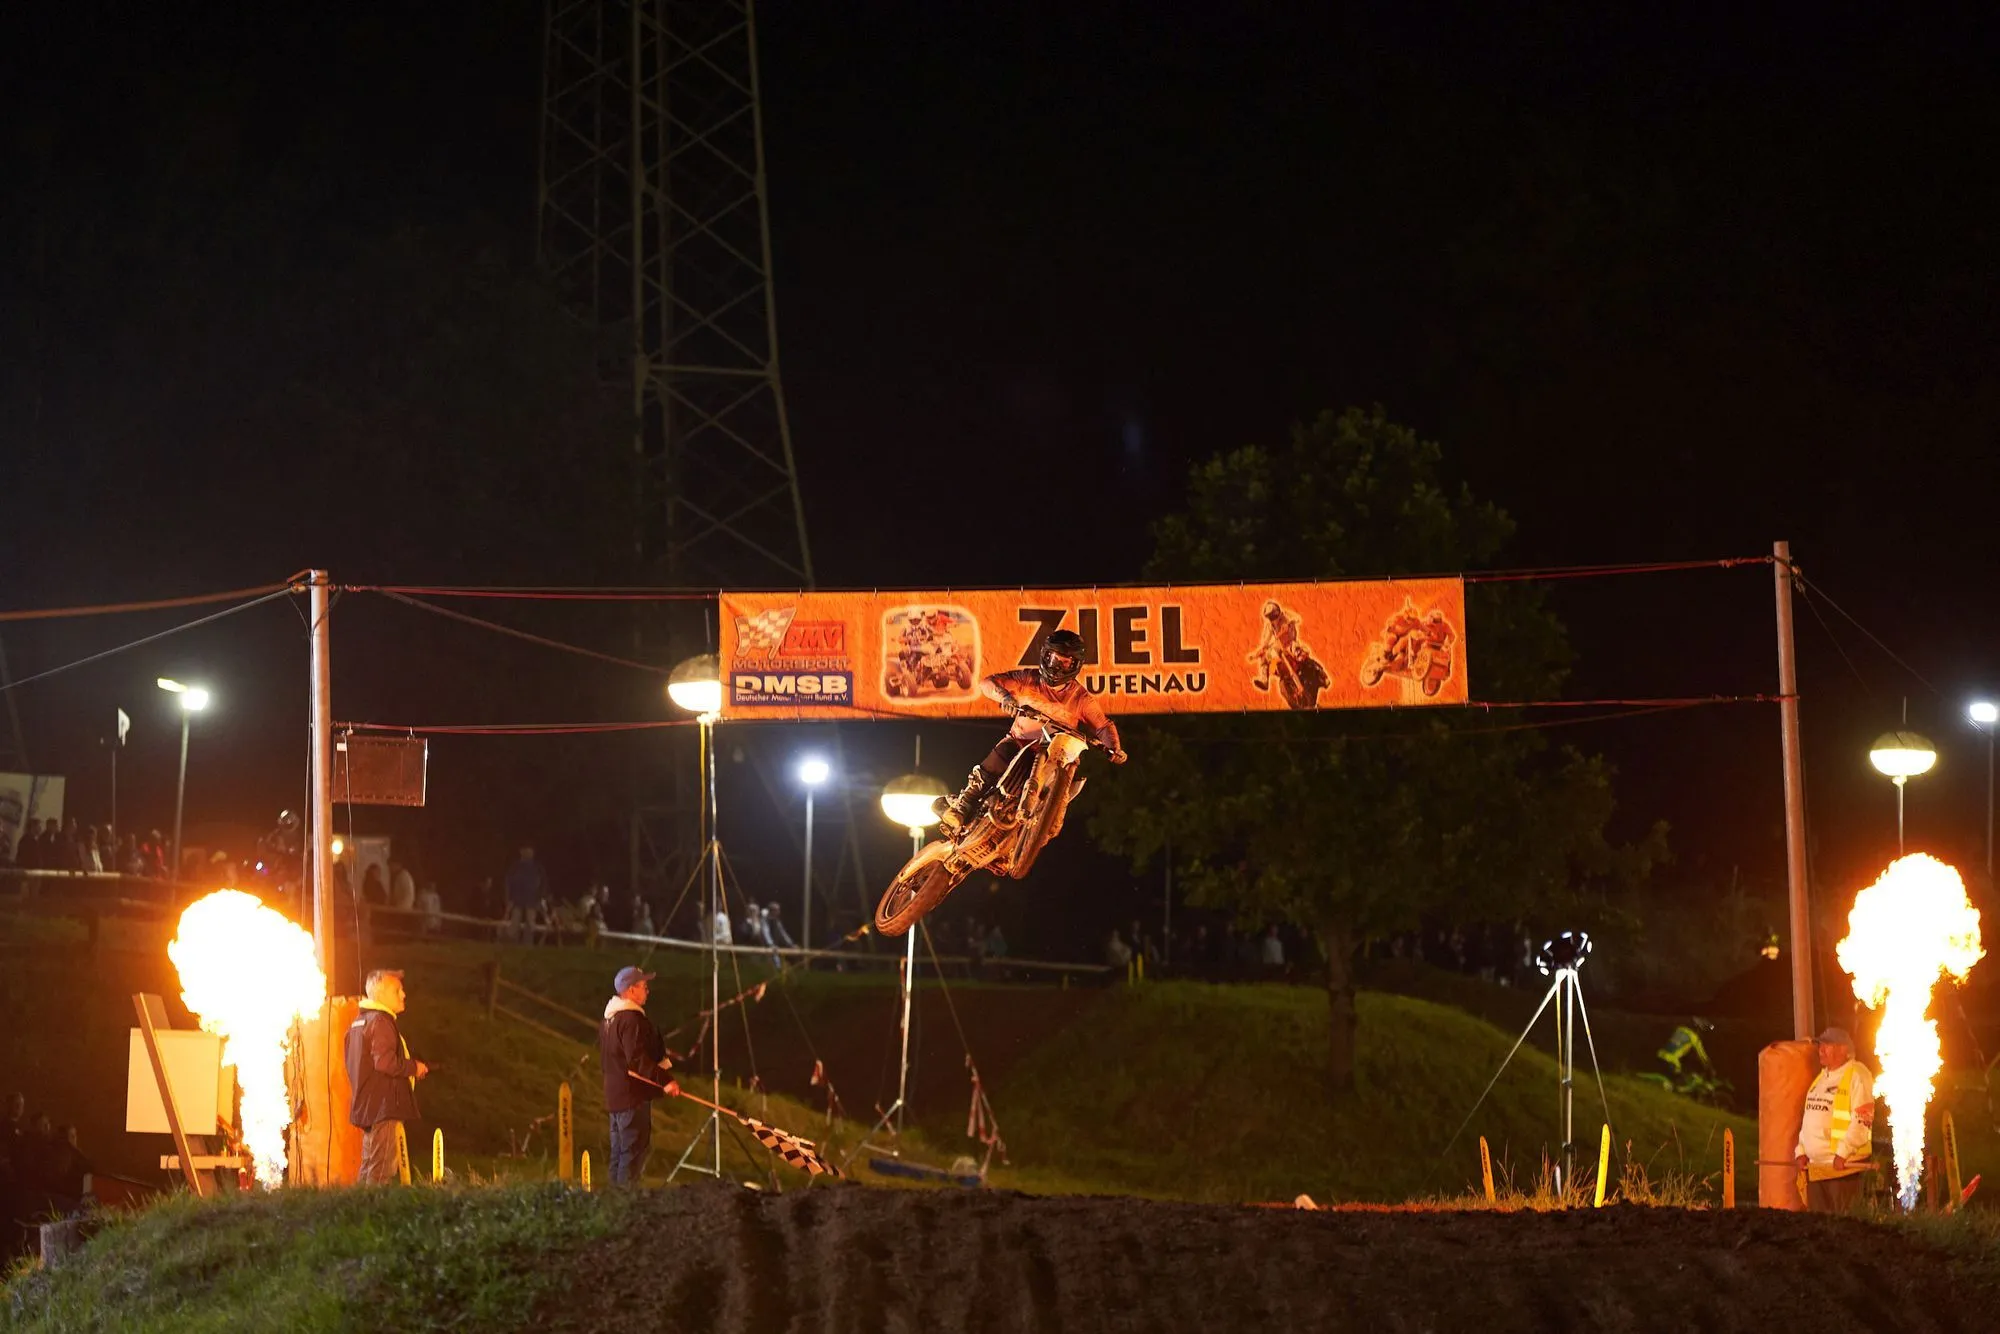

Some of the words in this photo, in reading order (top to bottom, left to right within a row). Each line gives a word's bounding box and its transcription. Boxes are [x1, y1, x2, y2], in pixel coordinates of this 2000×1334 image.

[788, 627, 841, 648] DMV
[1017, 605, 1200, 666] ZIEL
[732, 658, 850, 670] MOTORSPORT
[735, 675, 848, 695] DMSB
[1086, 672, 1205, 695] UFENAU
[736, 694, 769, 702] Deutscher
